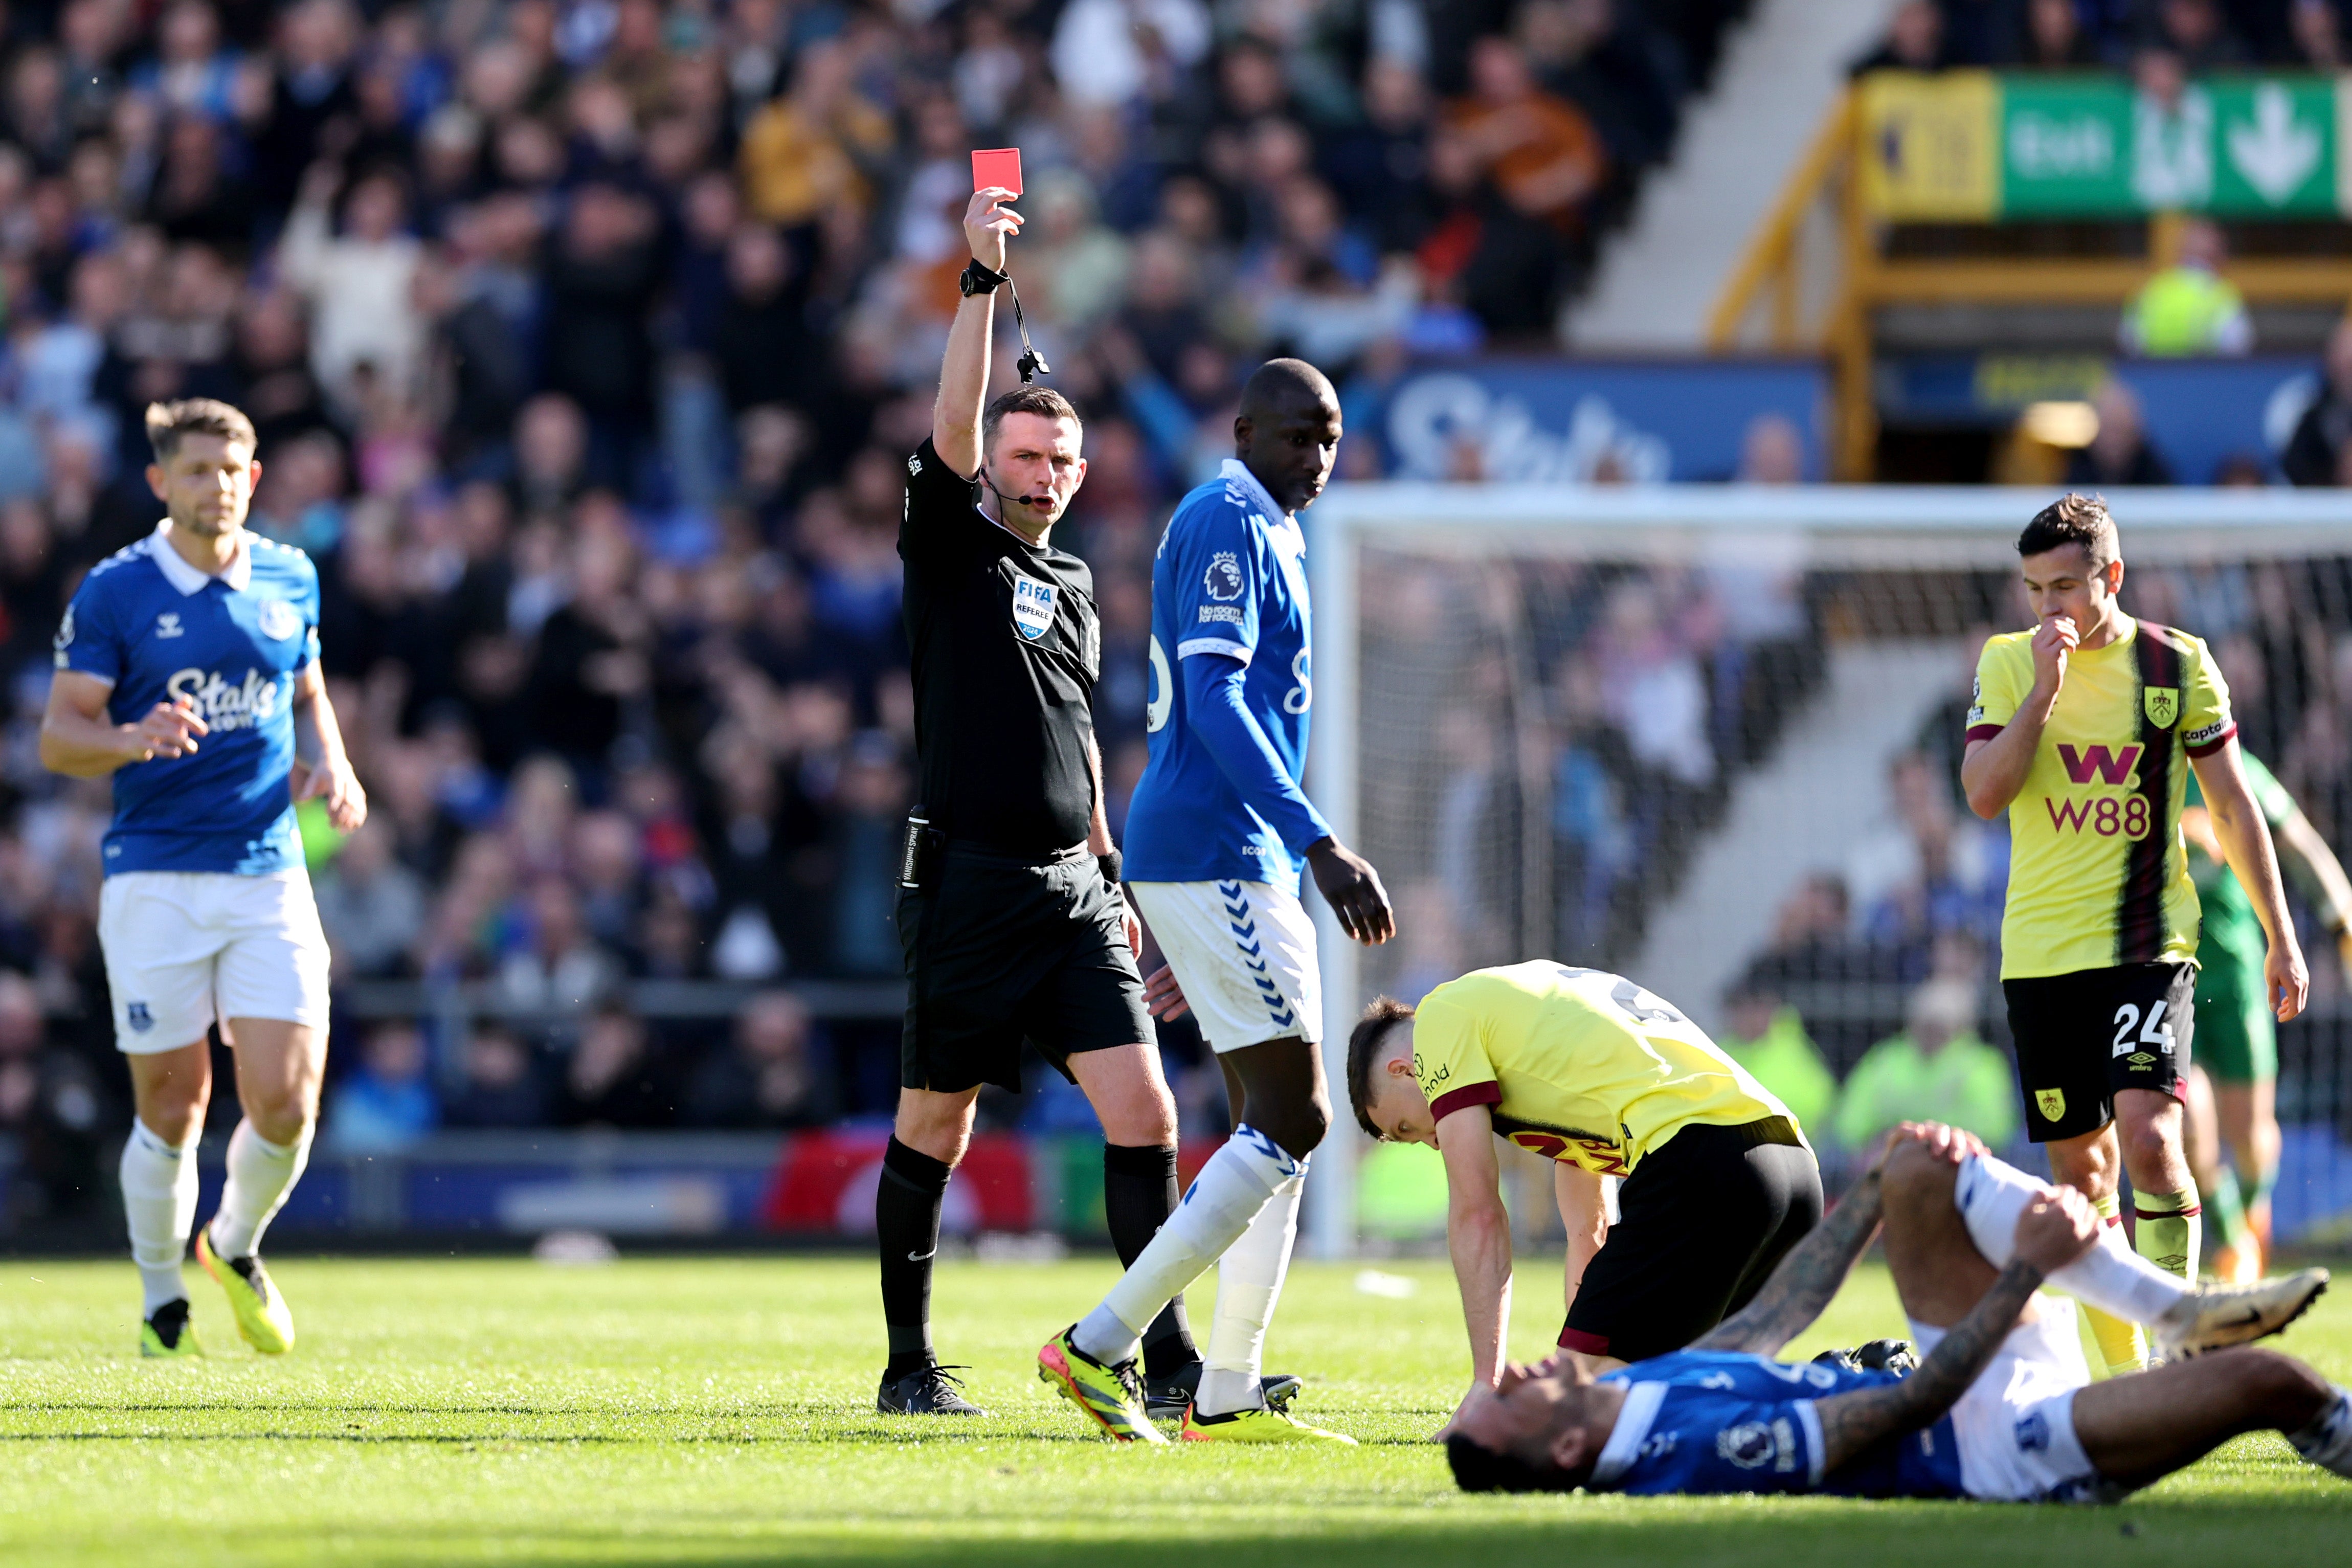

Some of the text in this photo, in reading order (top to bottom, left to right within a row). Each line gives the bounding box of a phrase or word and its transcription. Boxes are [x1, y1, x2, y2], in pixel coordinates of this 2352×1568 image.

[1019, 581, 1051, 603] FIFA
[1017, 604, 1049, 620] REFEREE
[1199, 605, 1241, 617] No room
[1023, 625, 1039, 635] 2024
[2045, 797, 2146, 836] W88
[904, 826, 919, 880] VANISHING SPRAY
[2112, 1000, 2176, 1059] 24
